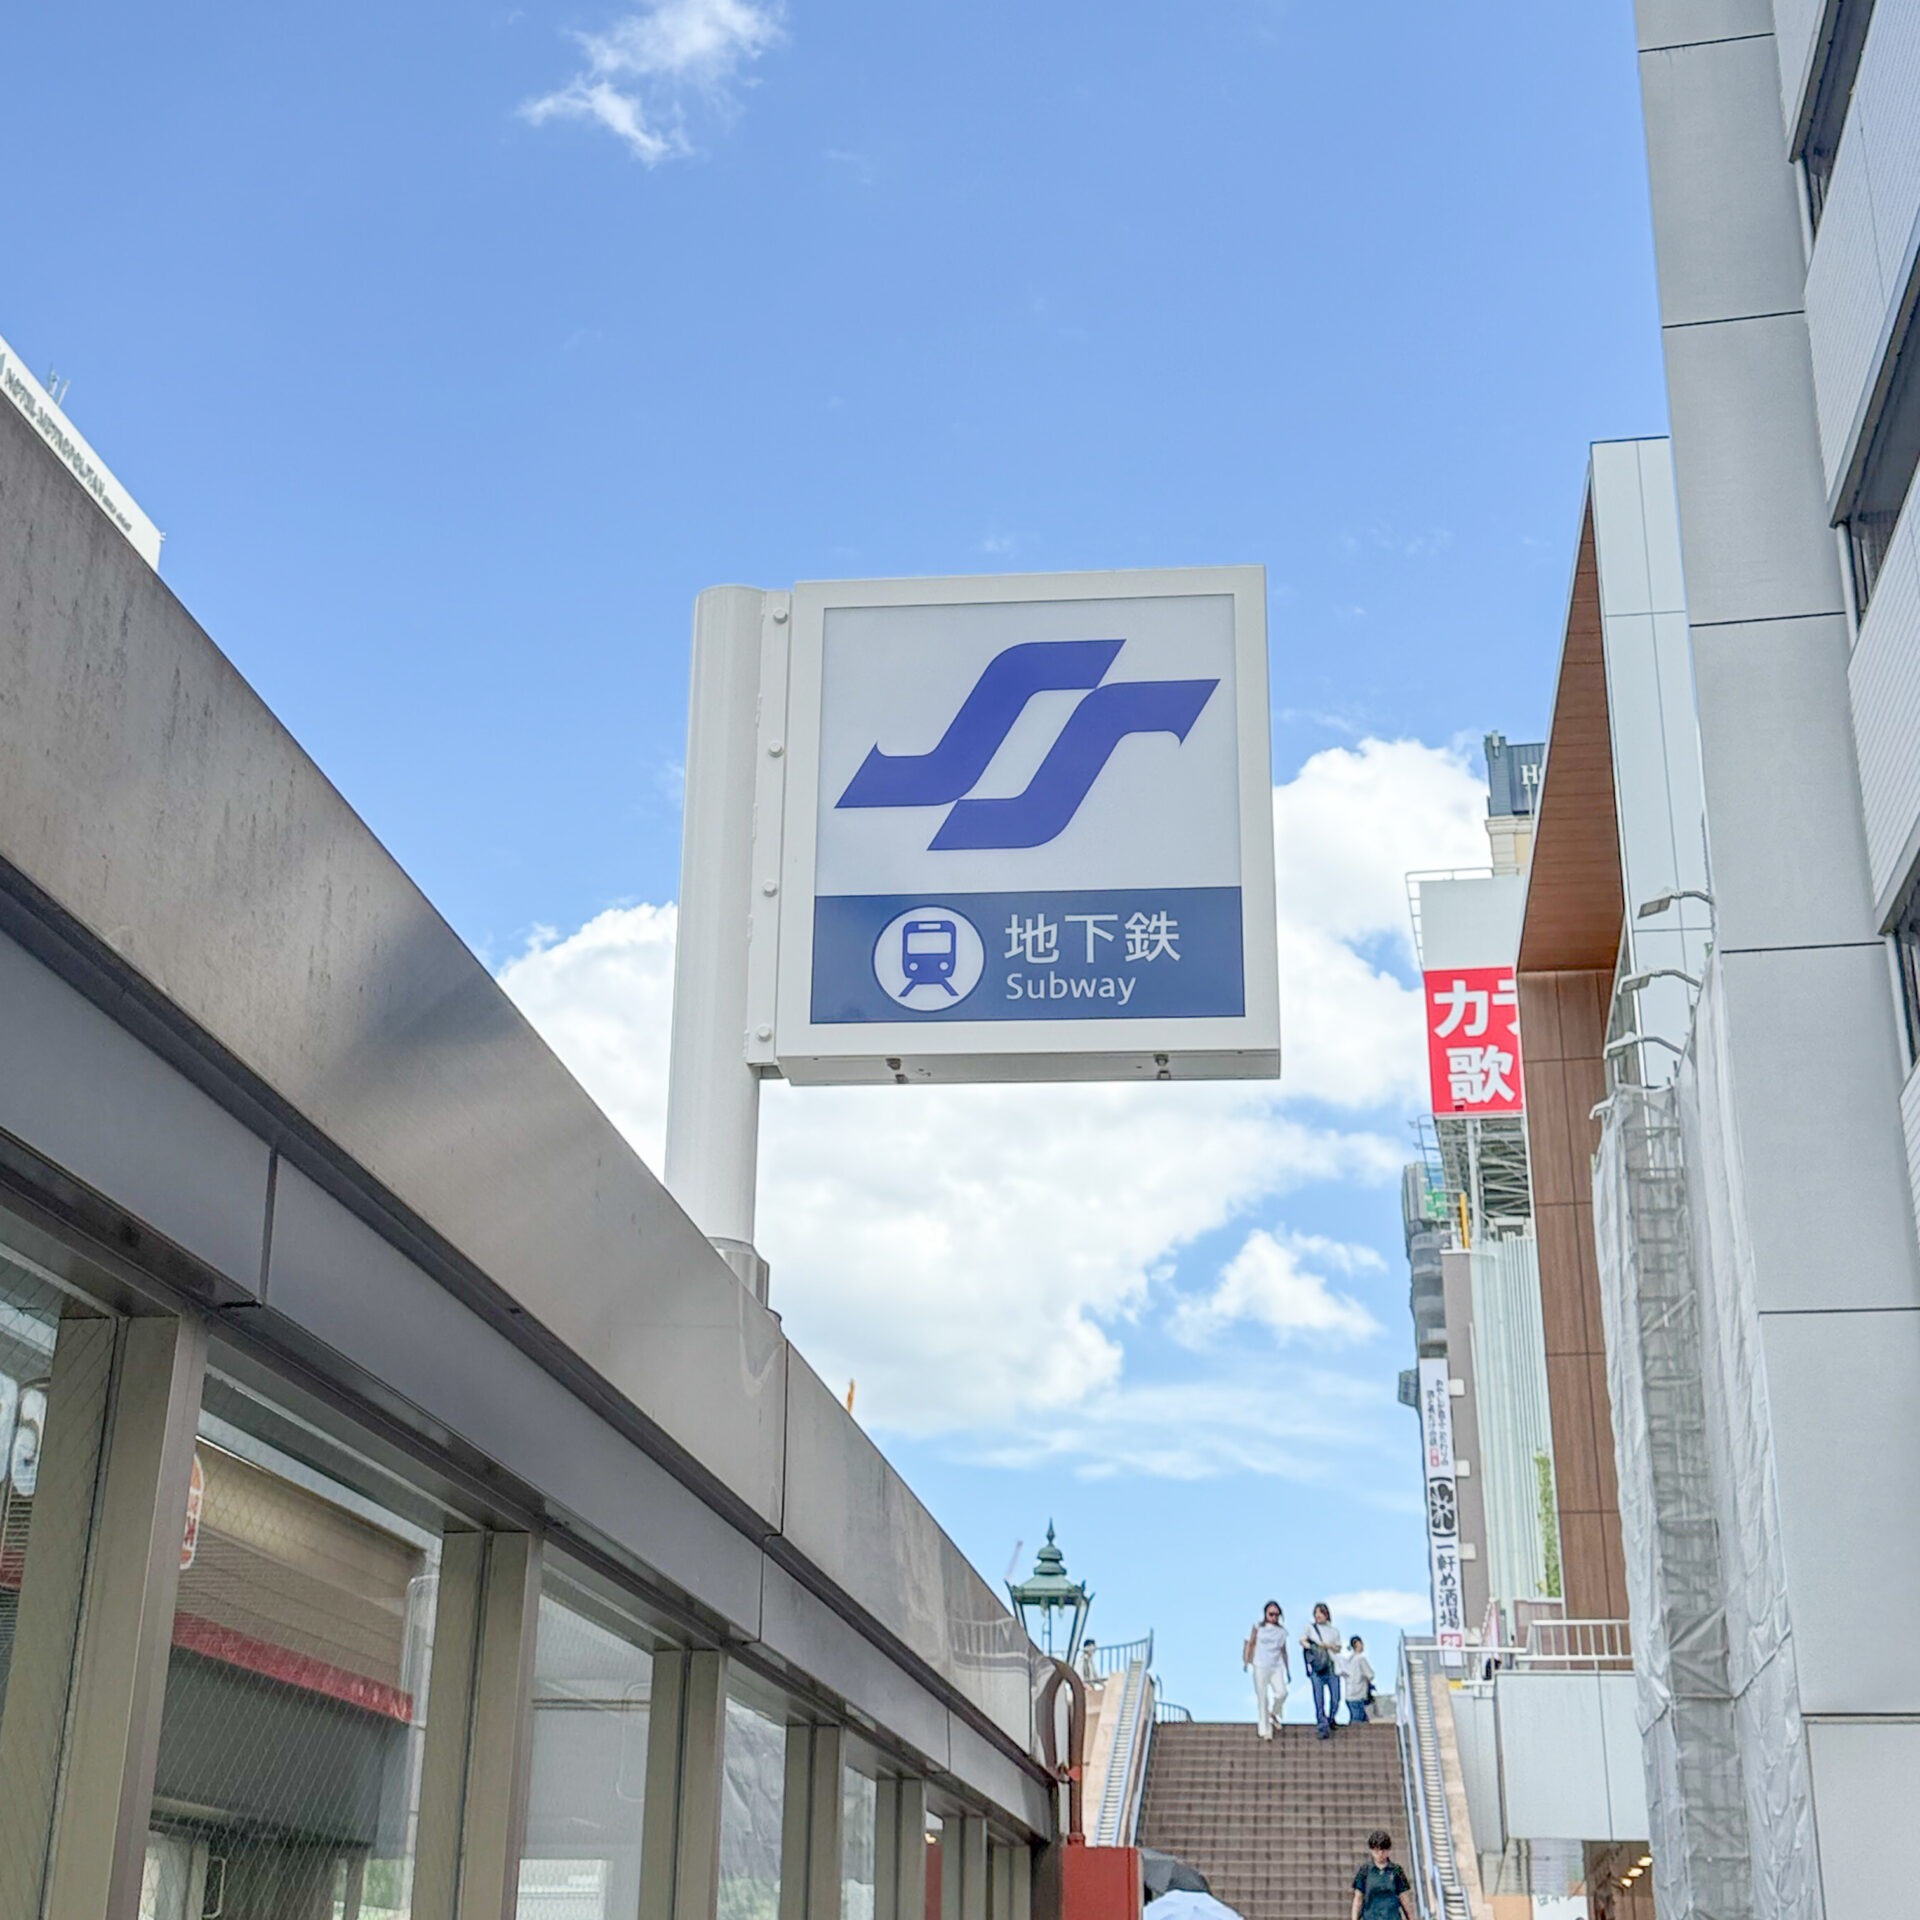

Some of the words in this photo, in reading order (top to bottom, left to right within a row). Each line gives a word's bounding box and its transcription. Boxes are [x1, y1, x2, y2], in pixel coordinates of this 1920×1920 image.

[1520, 763, 1543, 786] H
[1004, 910, 1182, 965] 地下鉄
[1006, 972, 1136, 1005] Subway
[1436, 1543, 1460, 1631] 一軒め酒場
